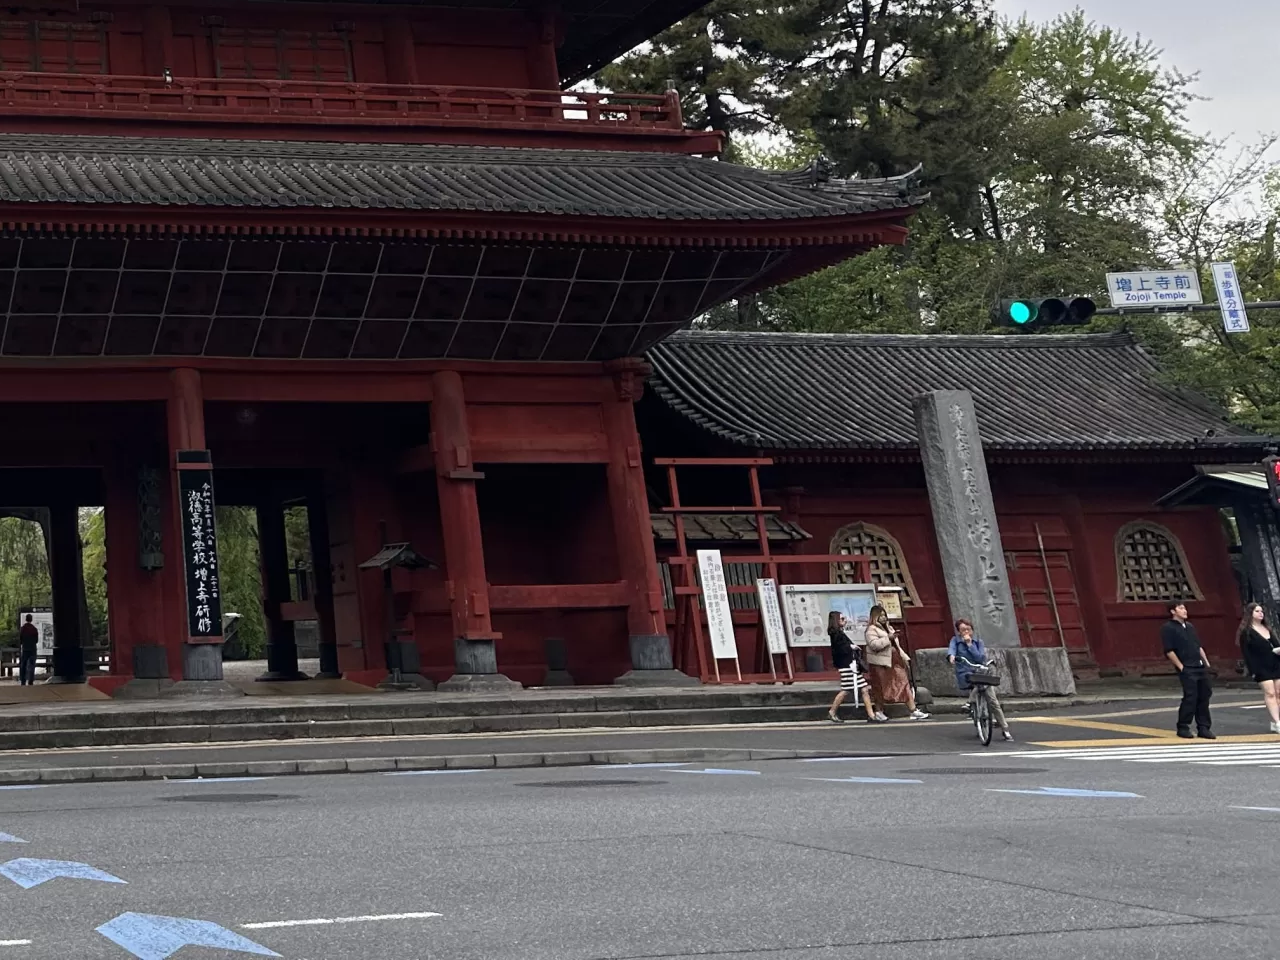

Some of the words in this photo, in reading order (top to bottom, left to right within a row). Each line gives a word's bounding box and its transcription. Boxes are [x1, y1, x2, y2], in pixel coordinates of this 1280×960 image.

[1115, 275, 1191, 292] 増上寺前
[1125, 292, 1151, 302] Zojoji
[1153, 291, 1186, 301] Temple
[1221, 267, 1243, 329] 一部歩車分離式
